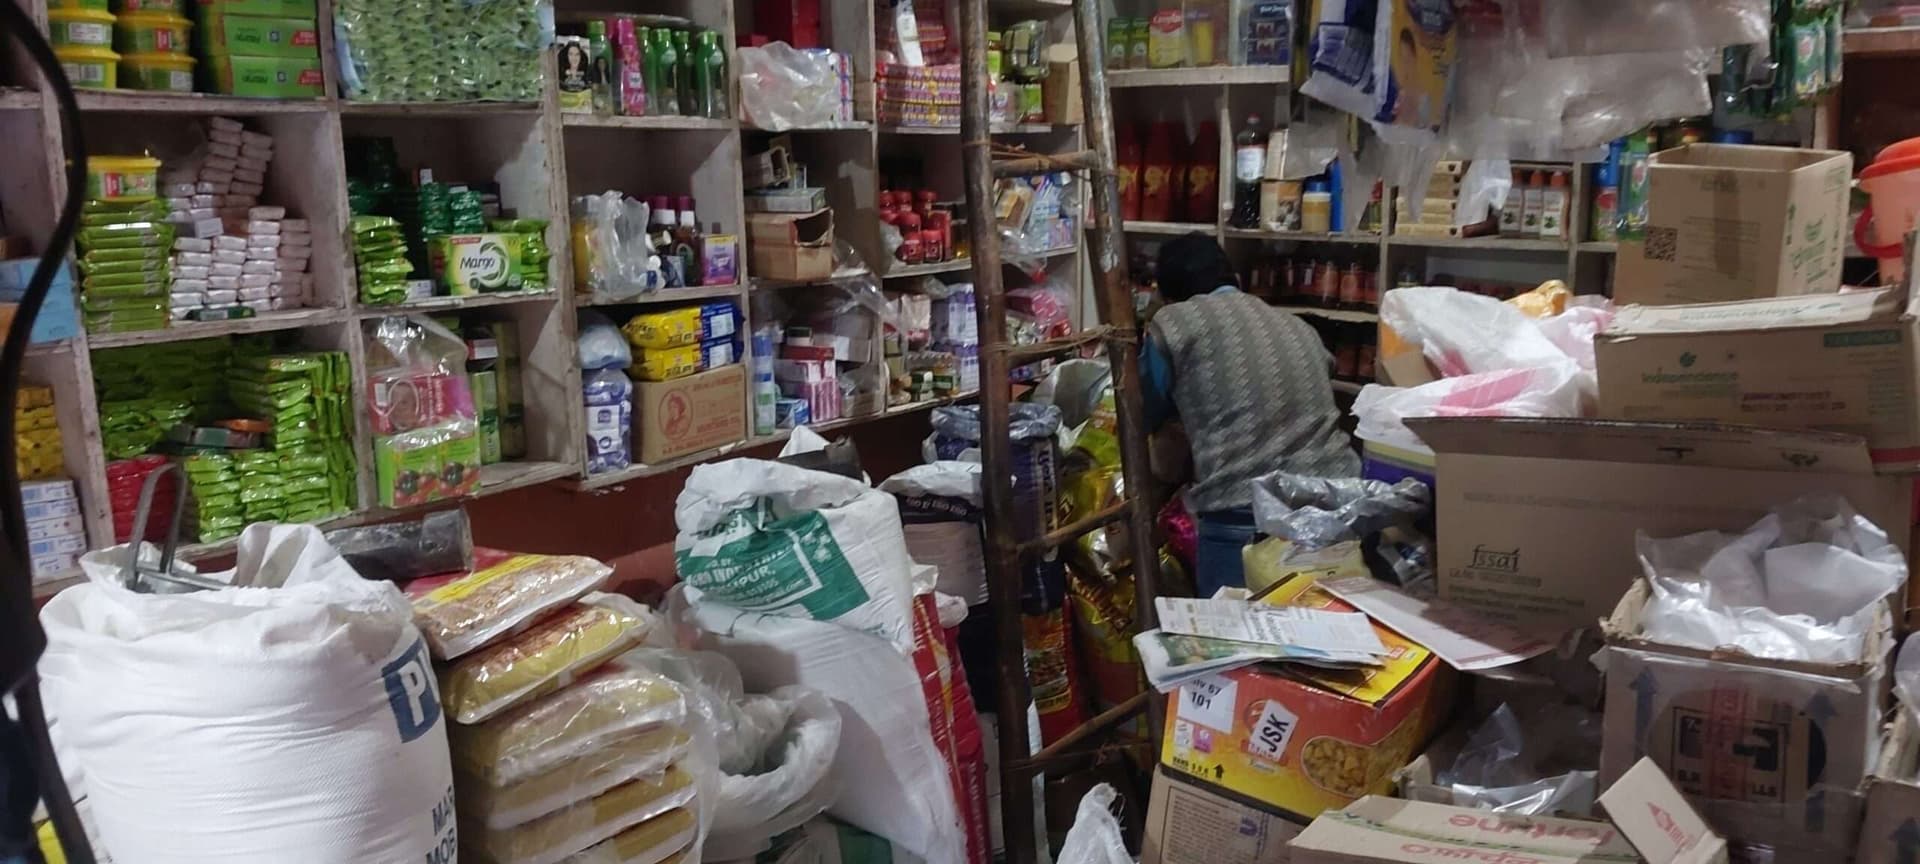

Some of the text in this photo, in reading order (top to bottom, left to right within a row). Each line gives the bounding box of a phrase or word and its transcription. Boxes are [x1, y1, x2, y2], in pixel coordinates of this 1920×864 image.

[460, 256, 496, 270] Margo
[1467, 544, 1521, 573] fssai
[1191, 692, 1212, 710] 101
[1260, 713, 1289, 753] JSK
